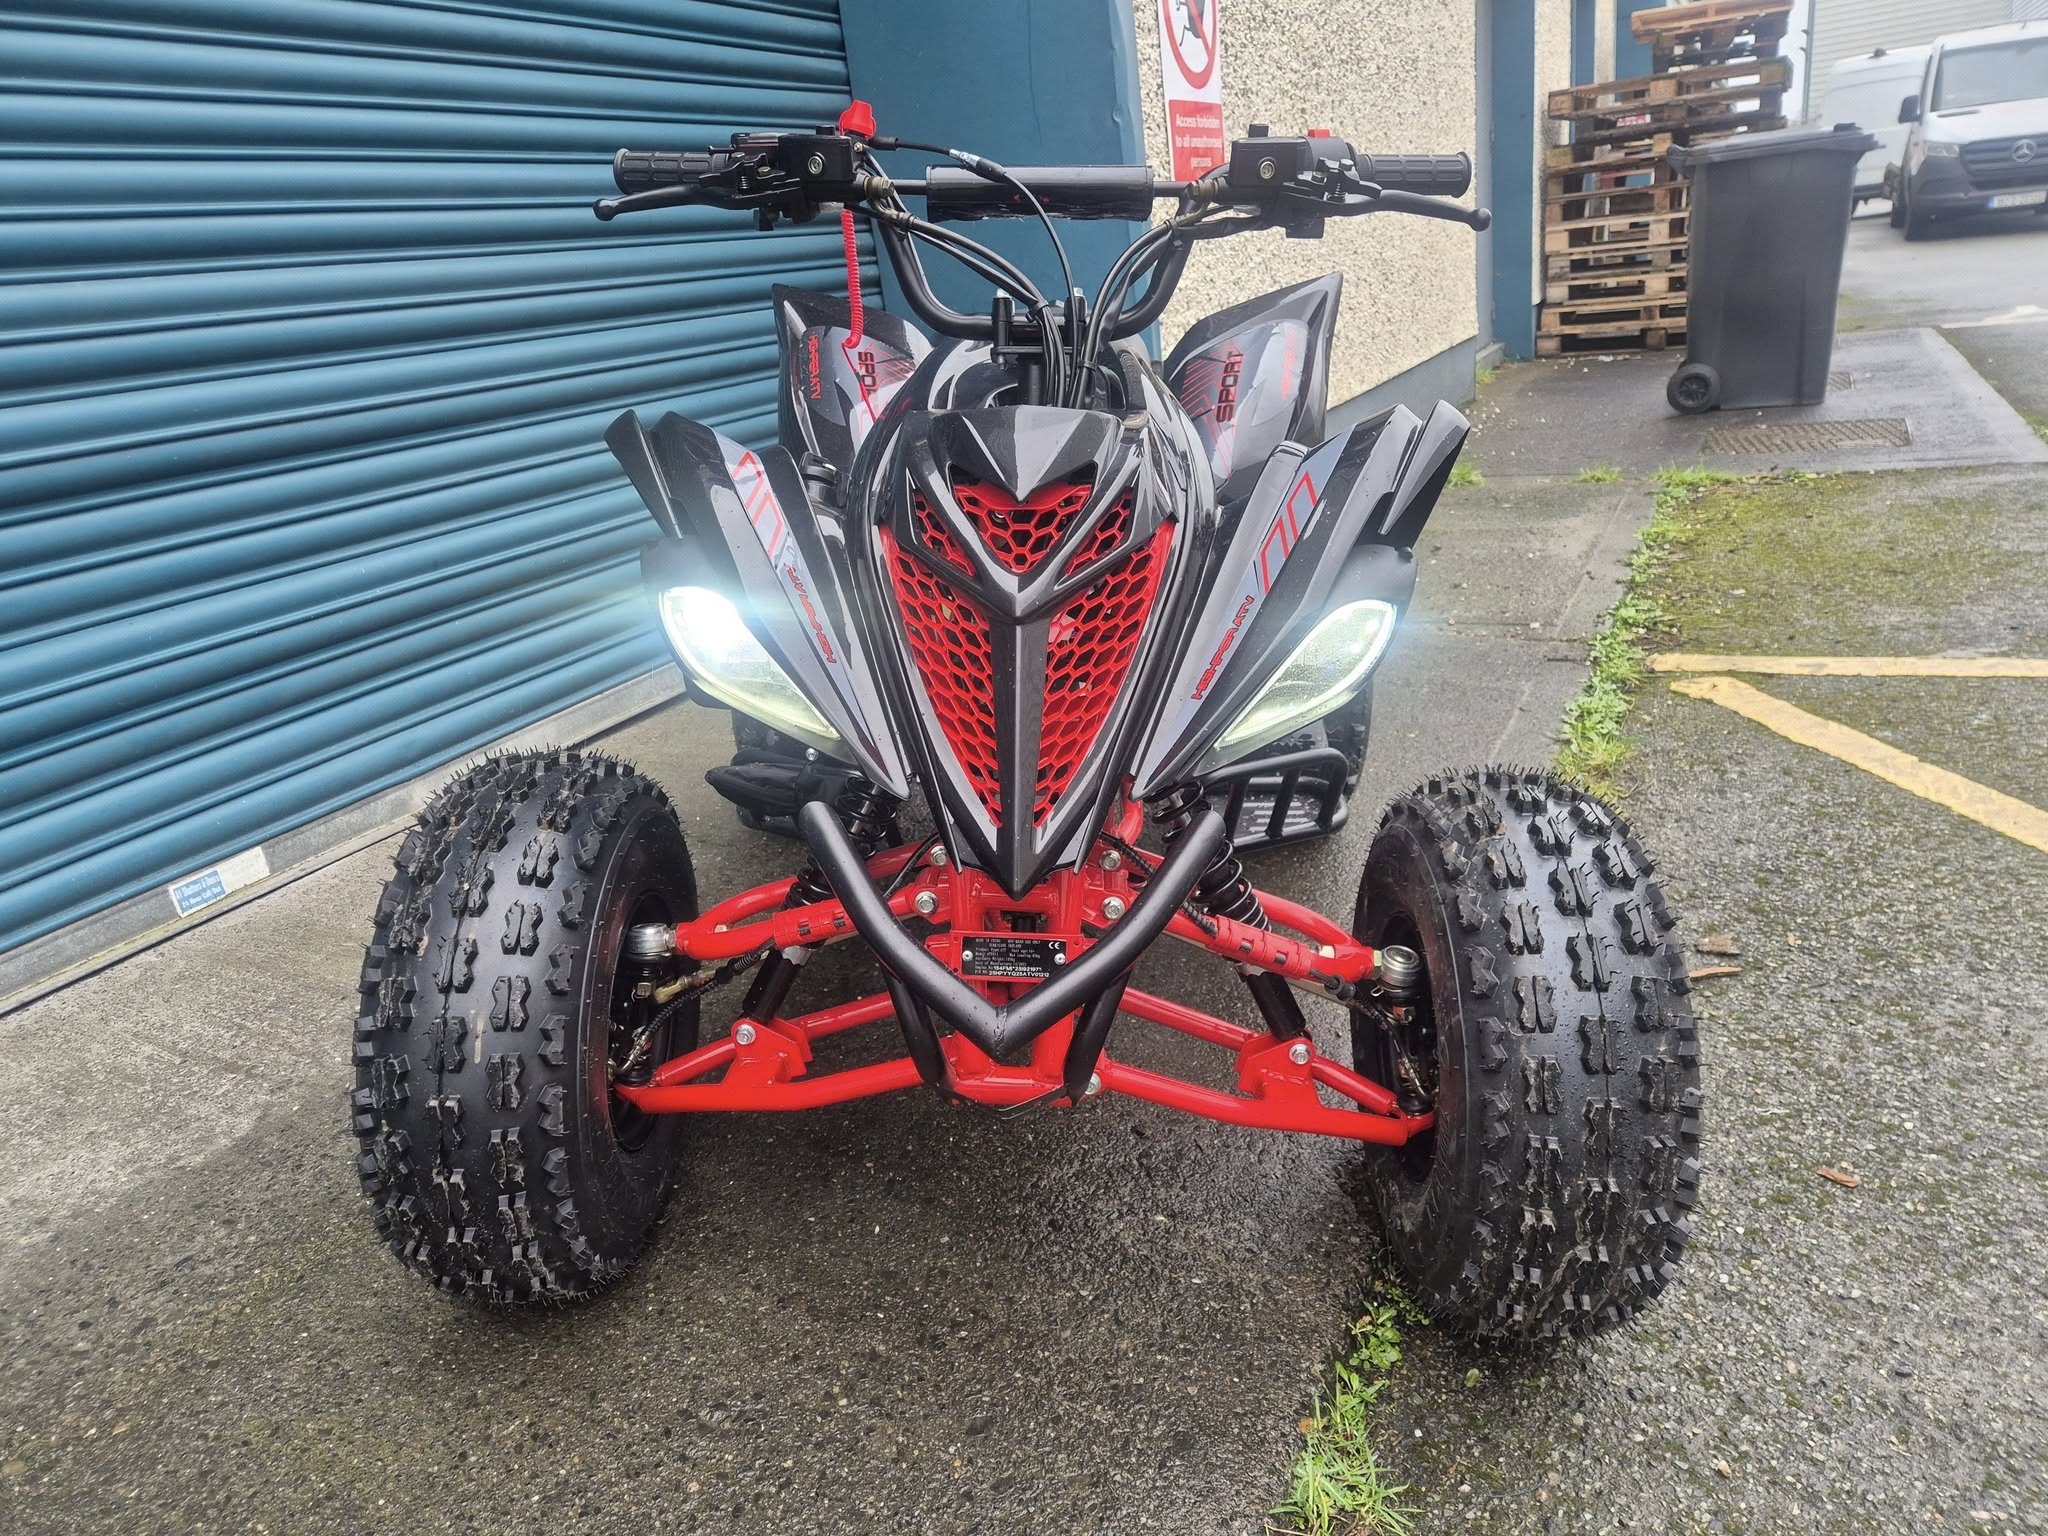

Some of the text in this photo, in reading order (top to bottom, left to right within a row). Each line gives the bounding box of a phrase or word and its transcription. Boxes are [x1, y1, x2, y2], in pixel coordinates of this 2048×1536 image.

[1175, 113, 1220, 129] Access forbidden
[1175, 135, 1183, 148] to
[1191, 157, 1213, 169] persons
[810, 377, 822, 399] ATV
[1216, 351, 1244, 423] SPORT
[1232, 595, 1254, 627] ATV
